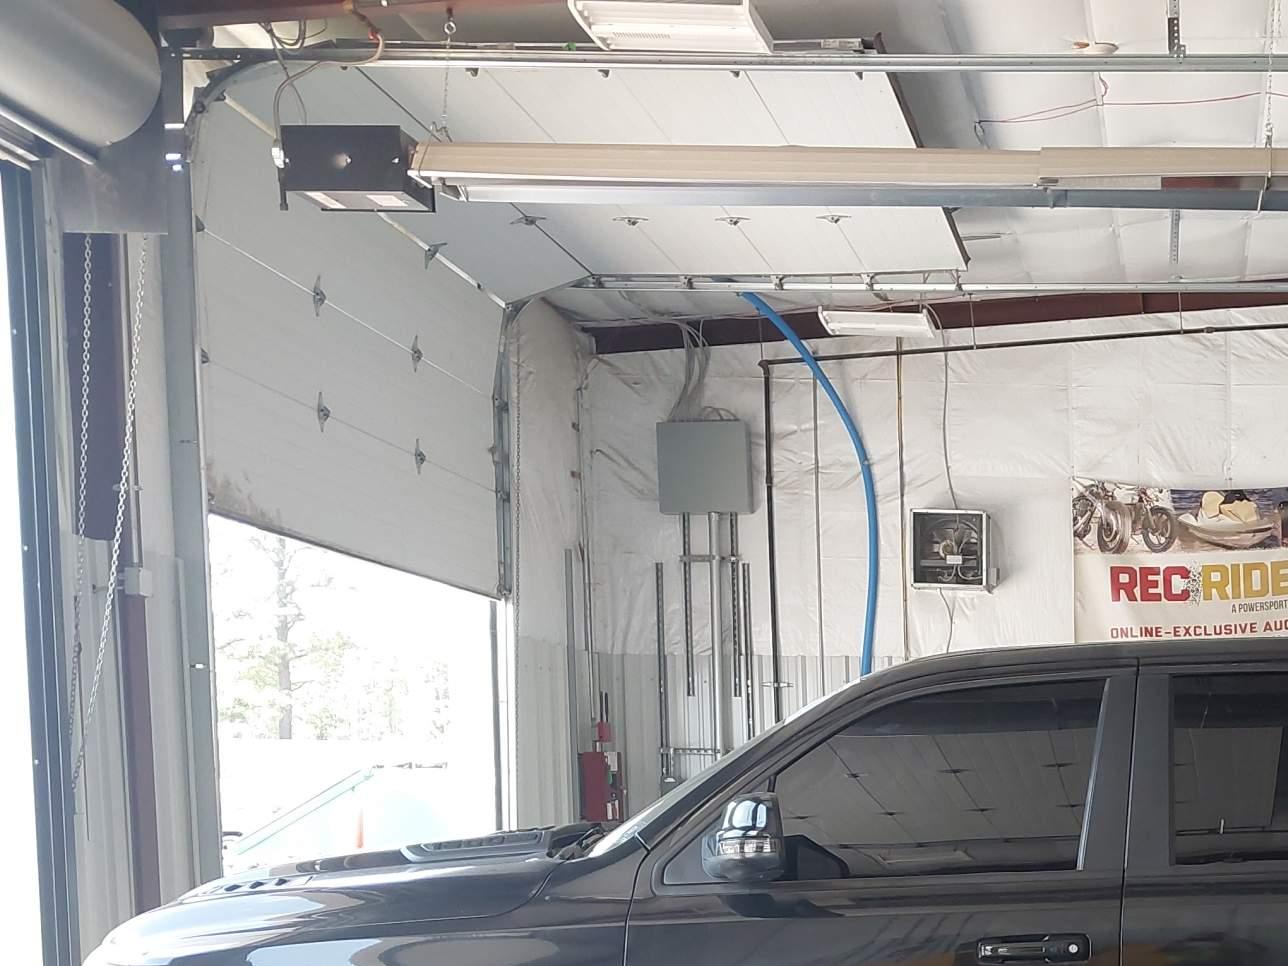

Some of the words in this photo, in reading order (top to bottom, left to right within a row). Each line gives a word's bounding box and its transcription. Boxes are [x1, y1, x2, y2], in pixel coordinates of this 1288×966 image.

[1110, 566, 1191, 602] REC
[1231, 603, 1237, 613] A
[1238, 600, 1288, 613] POWERSPORT
[1110, 622, 1258, 639] ONLINE-EXCLUSIVE
